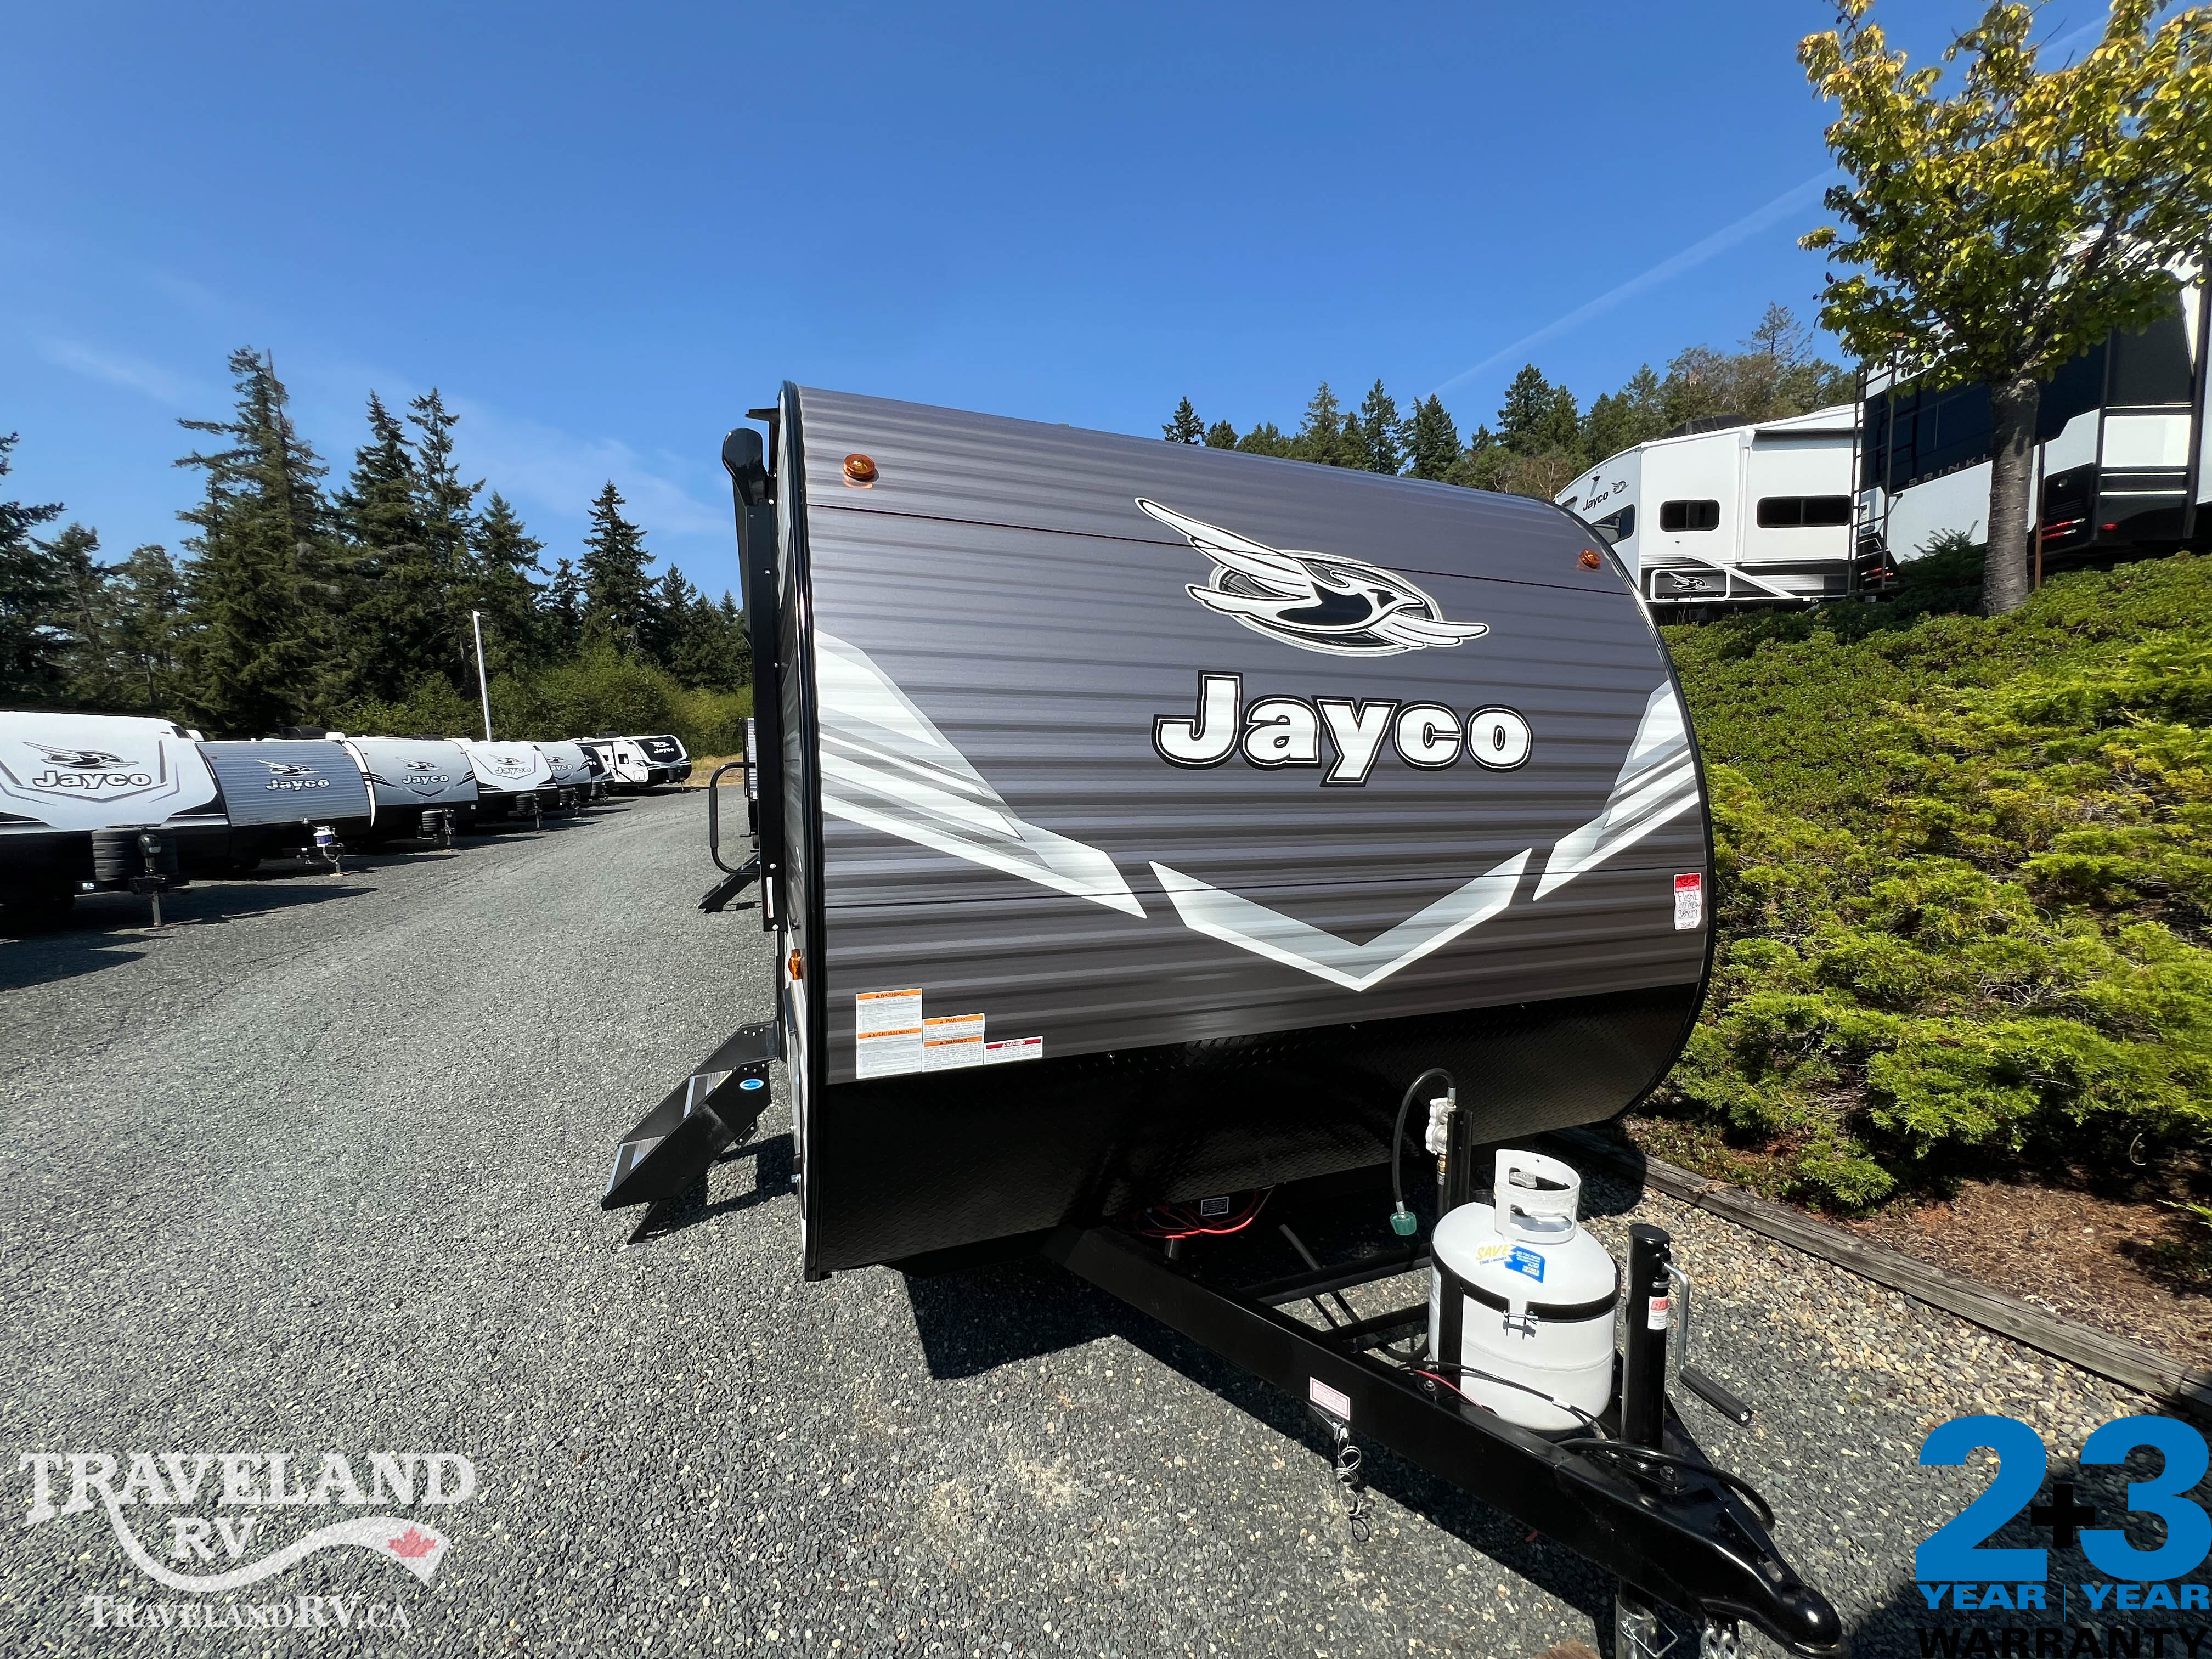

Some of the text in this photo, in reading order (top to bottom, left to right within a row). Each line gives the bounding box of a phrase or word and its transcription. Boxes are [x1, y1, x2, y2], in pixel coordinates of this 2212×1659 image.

[1583, 492, 1609, 511] Jayco
[1152, 670, 1534, 787] Jayco
[32, 770, 152, 789] Jayco
[265, 778, 330, 791] Jayco
[402, 774, 449, 785] Jayco
[1476, 1245, 1510, 1260] SAVE
